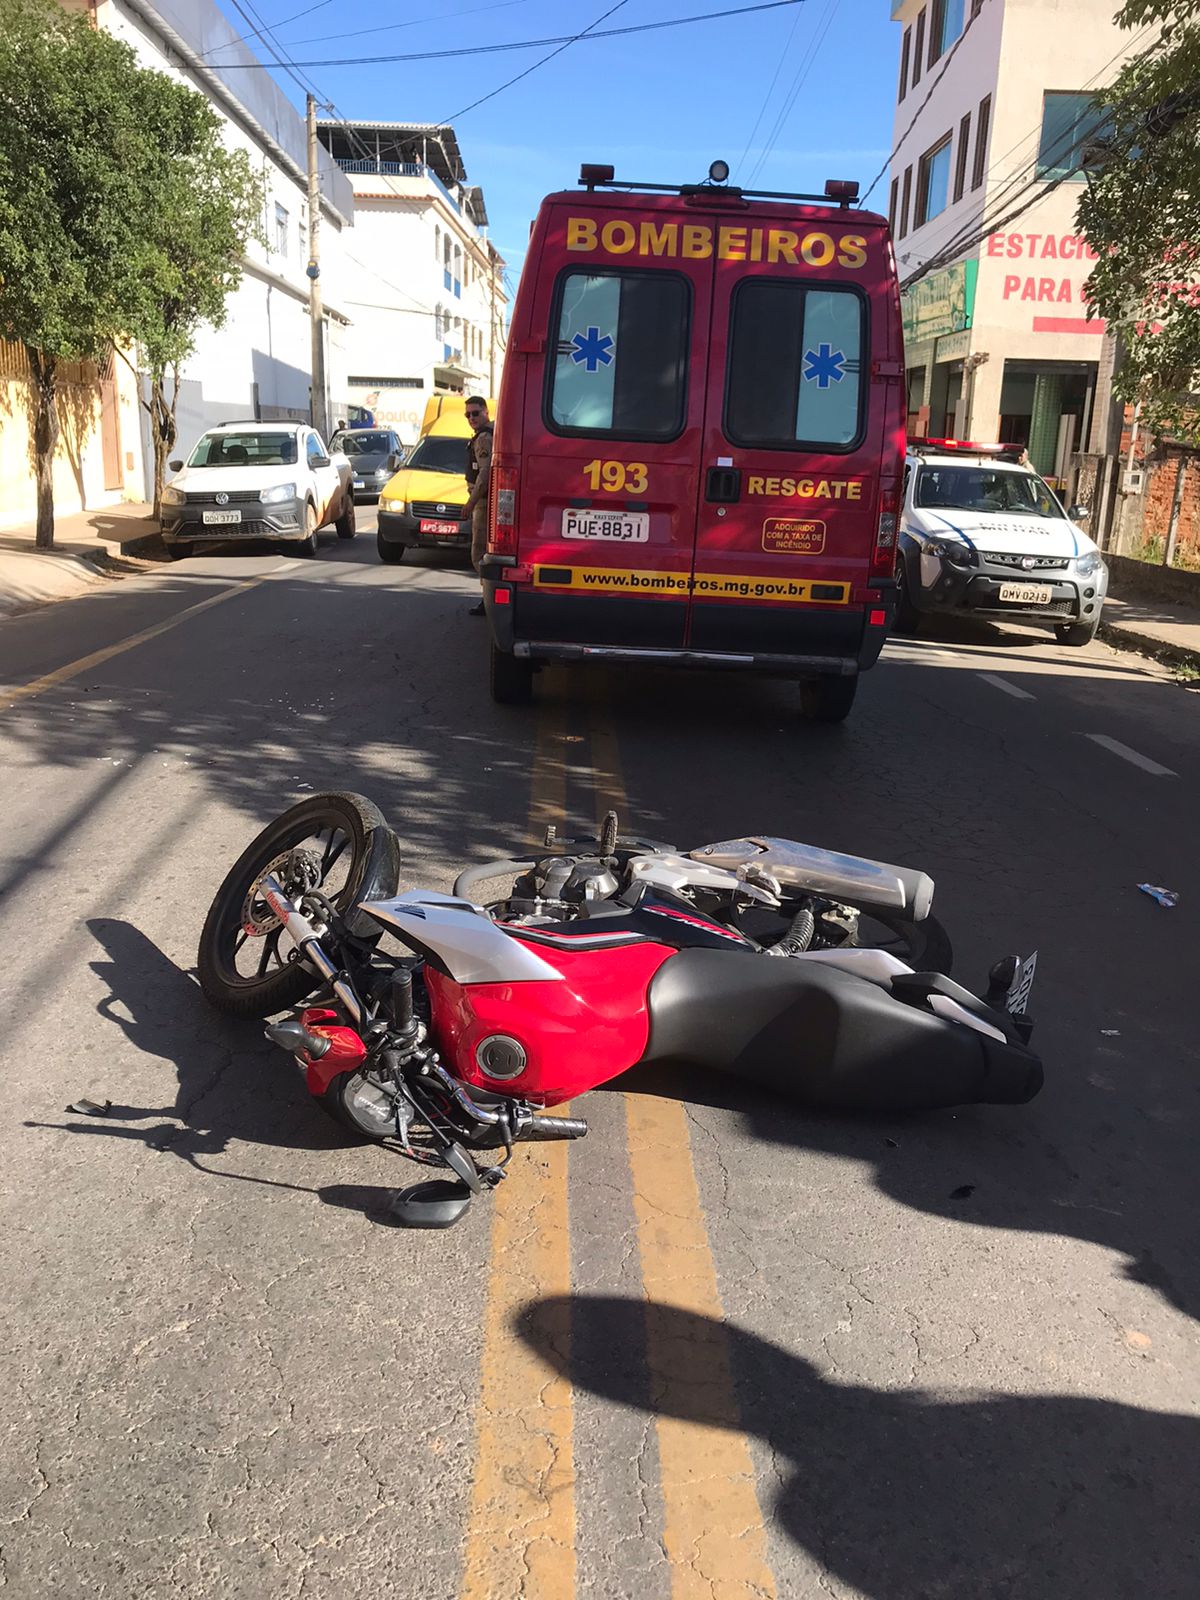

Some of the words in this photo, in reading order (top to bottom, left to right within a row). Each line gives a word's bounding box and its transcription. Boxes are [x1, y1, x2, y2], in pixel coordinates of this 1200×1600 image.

[566, 217, 868, 269] BOMBEIROS
[1003, 275, 1073, 303] PARA
[583, 459, 649, 494] 193
[747, 476, 862, 500] RESGATE
[766, 531, 783, 539] COM
[784, 532, 790, 540] A
[791, 532, 810, 541] TAXA
[811, 533, 822, 542] DE
[774, 523, 816, 532] ADQUIRIDO
[582, 573, 806, 596] www.bombeiros.mg.gov.br
